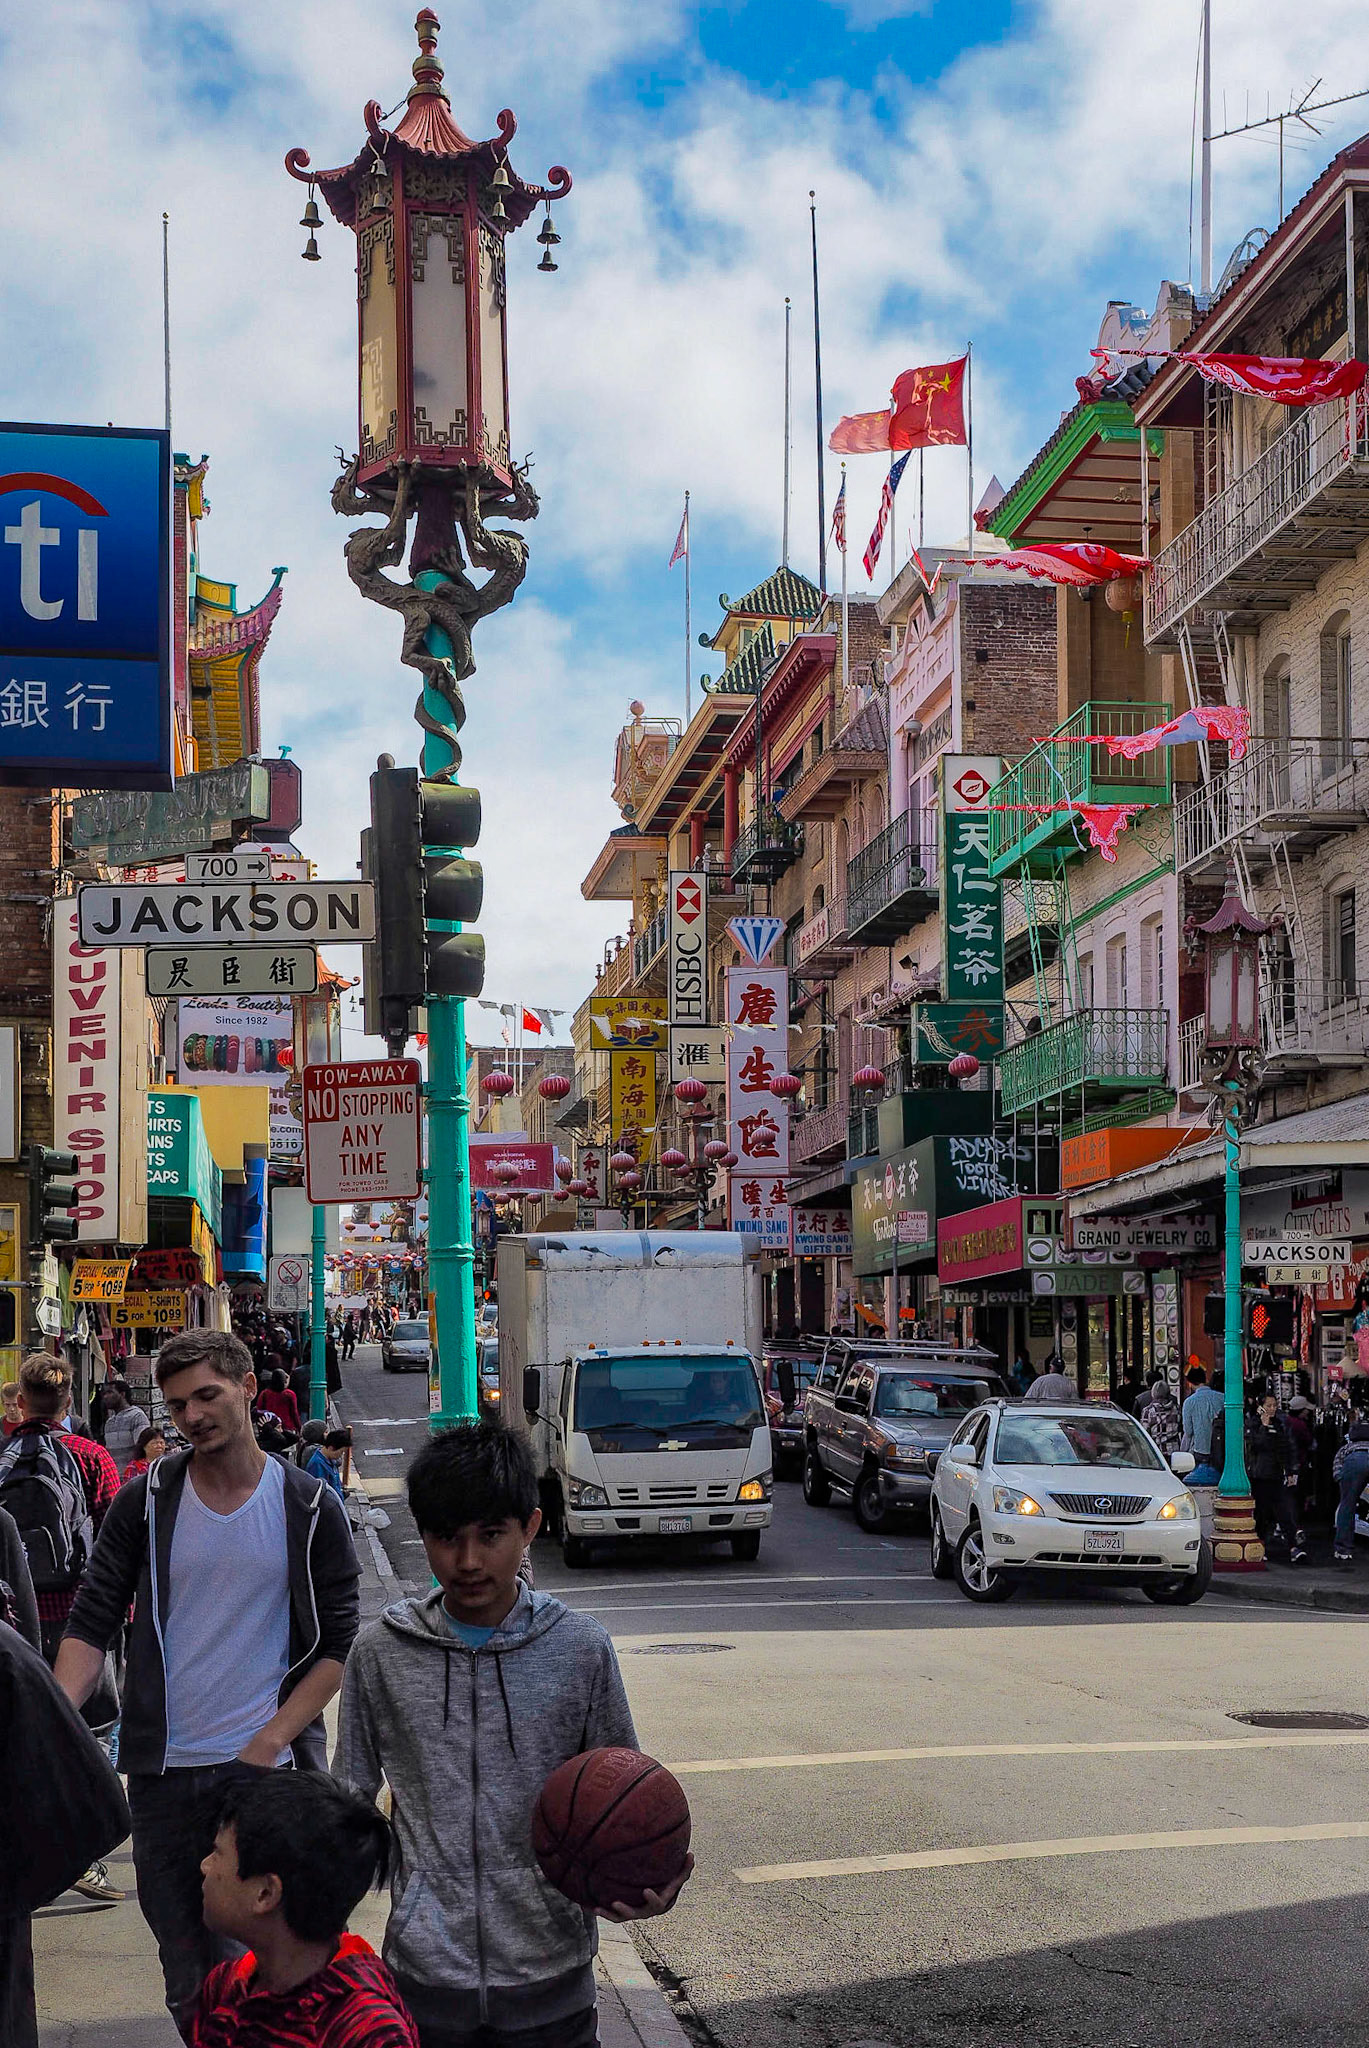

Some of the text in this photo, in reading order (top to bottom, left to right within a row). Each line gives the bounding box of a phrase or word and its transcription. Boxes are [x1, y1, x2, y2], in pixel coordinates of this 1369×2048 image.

[198, 858, 238, 877] 700
[93, 893, 360, 935] JACKSON
[675, 932, 702, 1021] HSBC
[215, 1016, 268, 1025] Since 1982
[313, 1064, 408, 1085] TOW-AWAY
[307, 1088, 413, 1119] NO STOPPING
[341, 1124, 383, 1147] ANY
[339, 1151, 387, 1175] TIME
[735, 1220, 763, 1233] KWONG
[766, 1220, 788, 1234] SANG
[1286, 1231, 1302, 1239] 700
[795, 1234, 849, 1244] KWONG SANG
[1078, 1230, 1121, 1245] GRAND
[1127, 1230, 1188, 1245] JEWELRY
[804, 1245, 831, 1253] GIFTS
[1248, 1245, 1345, 1260] JACKSON
[73, 1278, 83, 1296] 5
[1059, 1273, 1109, 1292] JADE
[150, 1295, 181, 1307] T-SHIRTS
[943, 1288, 1040, 1307] Fine Jewelry
[115, 1309, 129, 1324] 5
[131, 1312, 145, 1321] FOR
